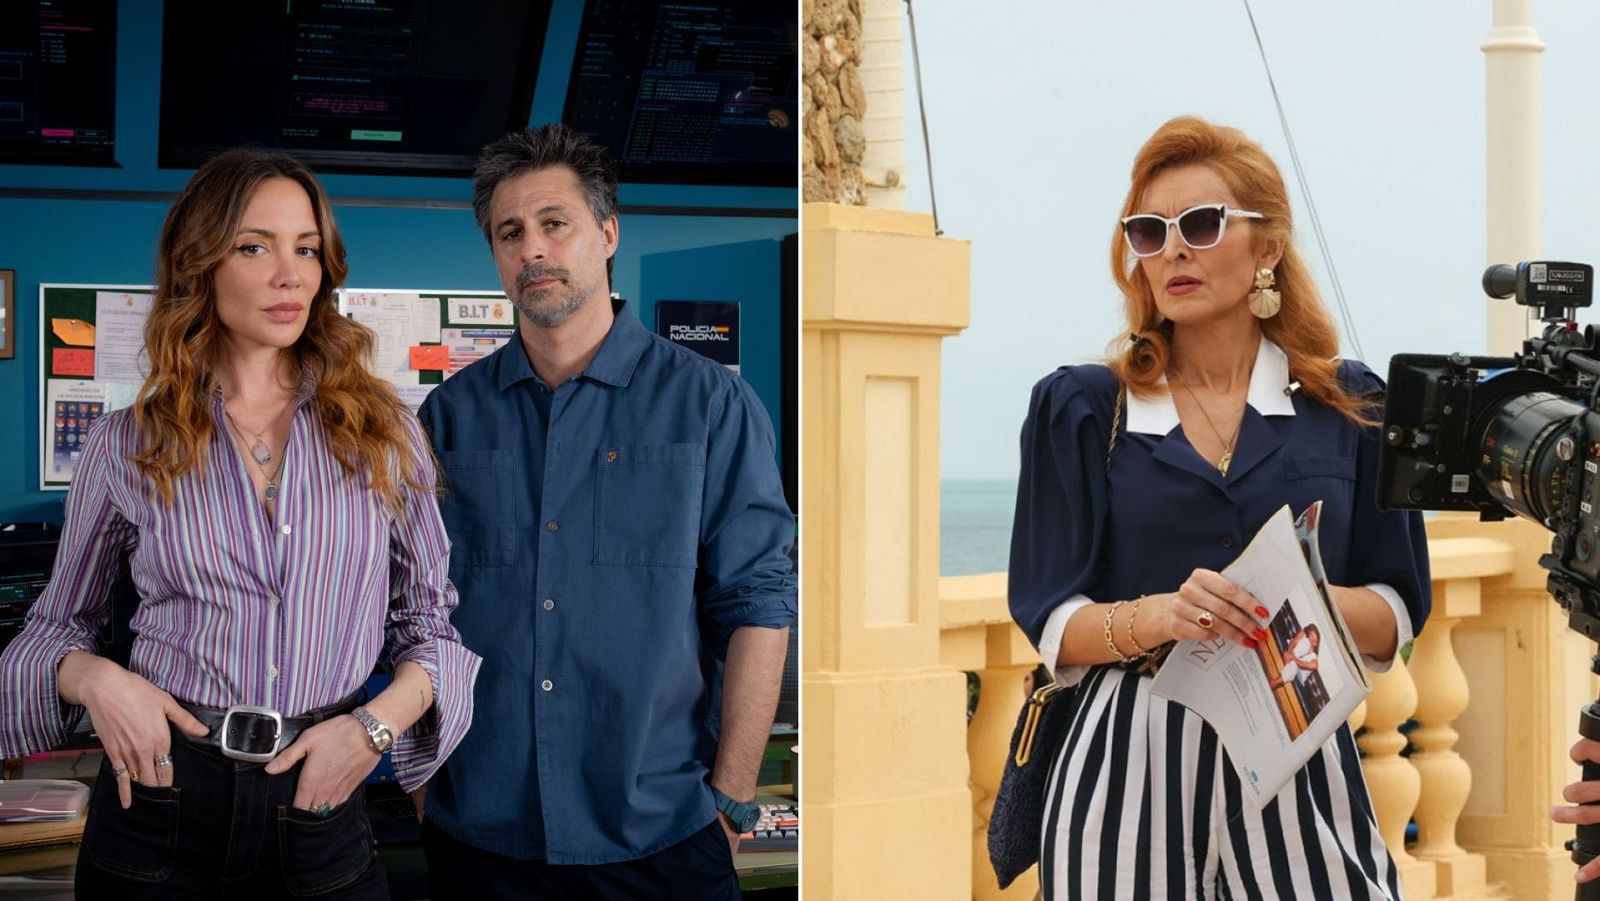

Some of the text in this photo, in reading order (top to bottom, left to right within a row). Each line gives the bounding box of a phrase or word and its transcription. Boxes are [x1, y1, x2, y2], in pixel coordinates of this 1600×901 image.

[459, 305, 488, 319] B.I.T
[670, 325, 716, 333] POLICIA
[670, 333, 729, 341] NACIONAL
